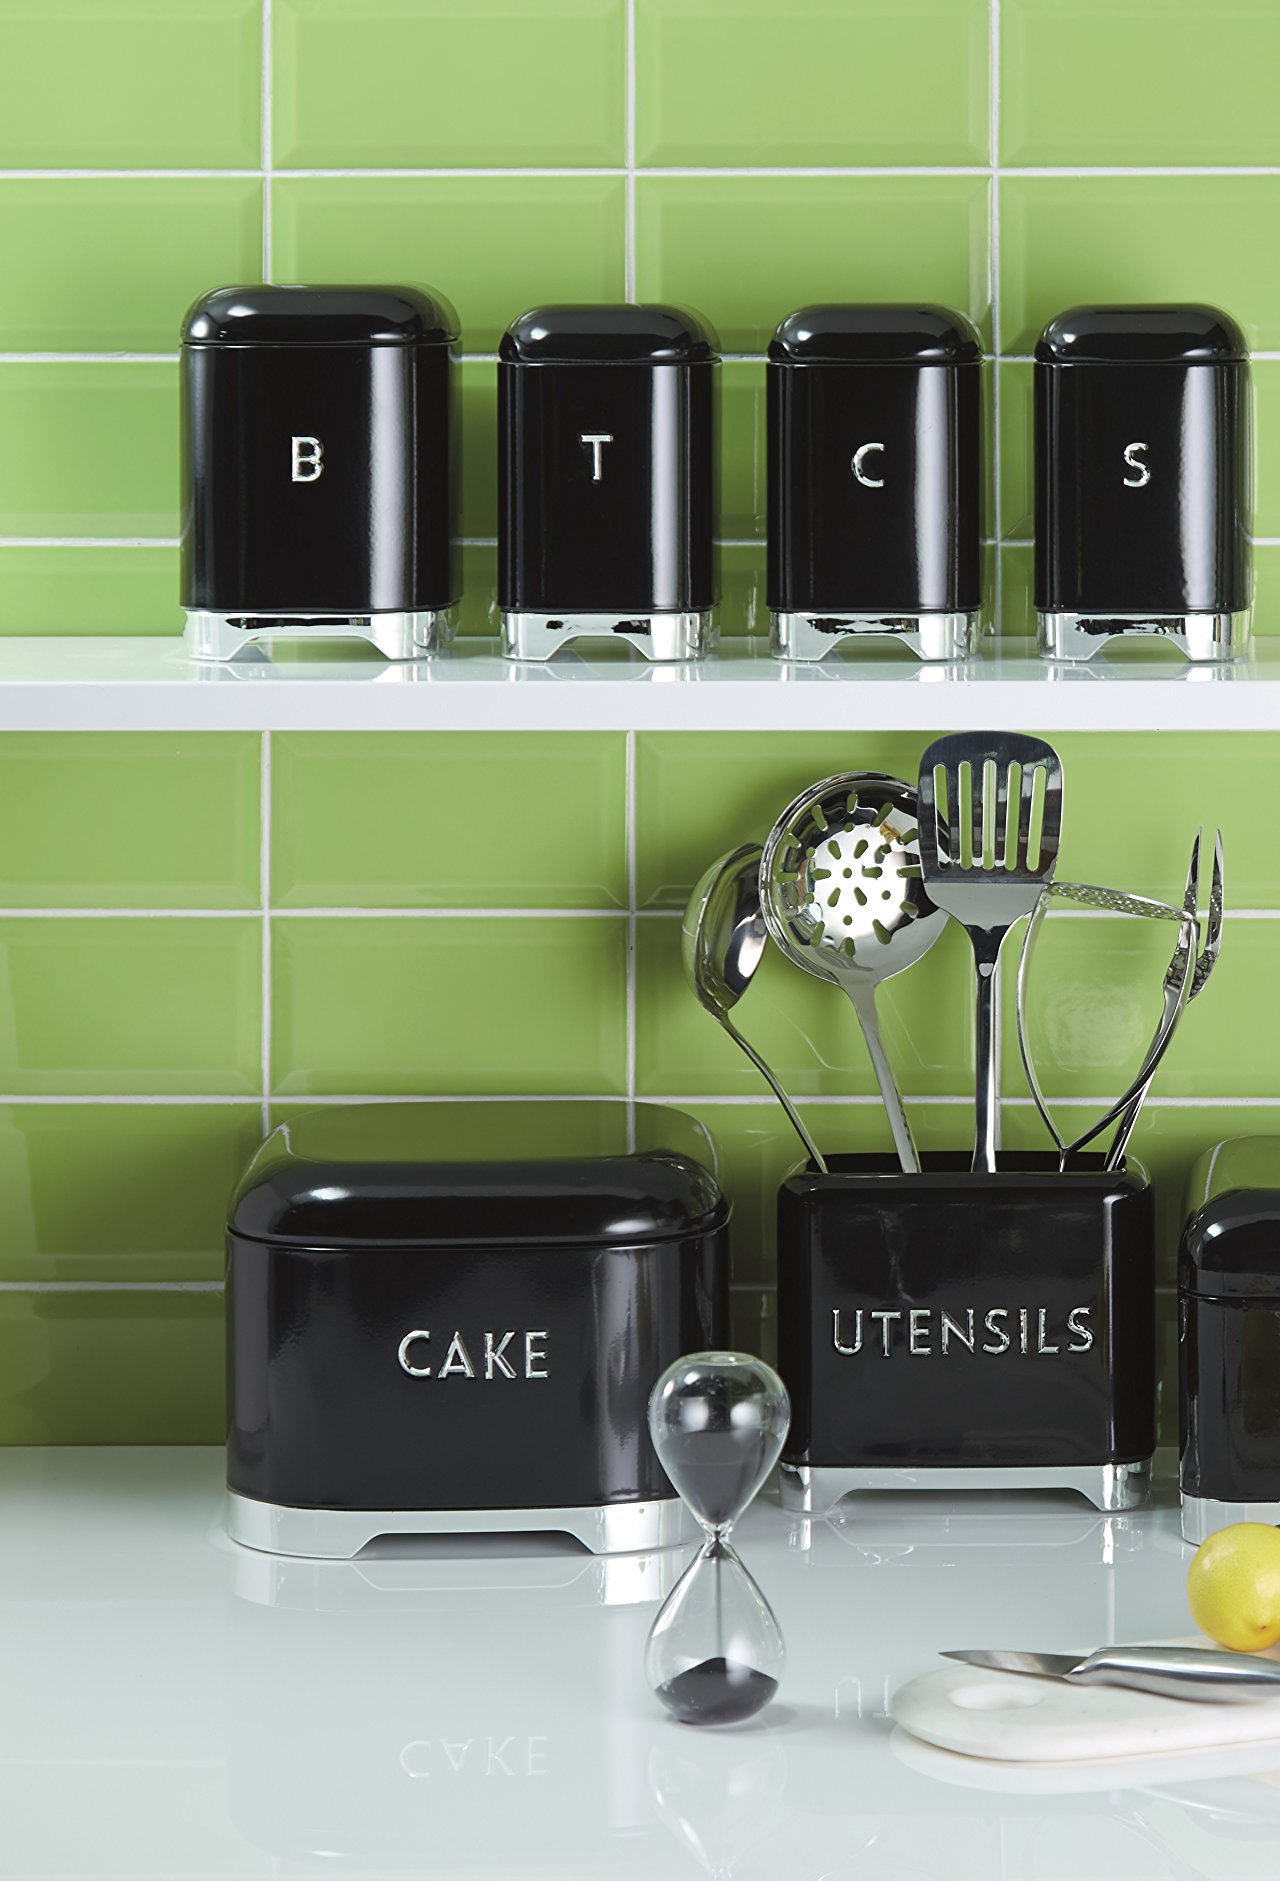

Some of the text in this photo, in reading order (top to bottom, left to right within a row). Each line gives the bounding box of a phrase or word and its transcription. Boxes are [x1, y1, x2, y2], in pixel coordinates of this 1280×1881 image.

[289, 435, 325, 484] B
[580, 433, 614, 483] T
[851, 441, 886, 489] C
[1122, 441, 1152, 490] S
[397, 1329, 551, 1380] CAKE
[831, 1306, 1094, 1357] UTENSILS
